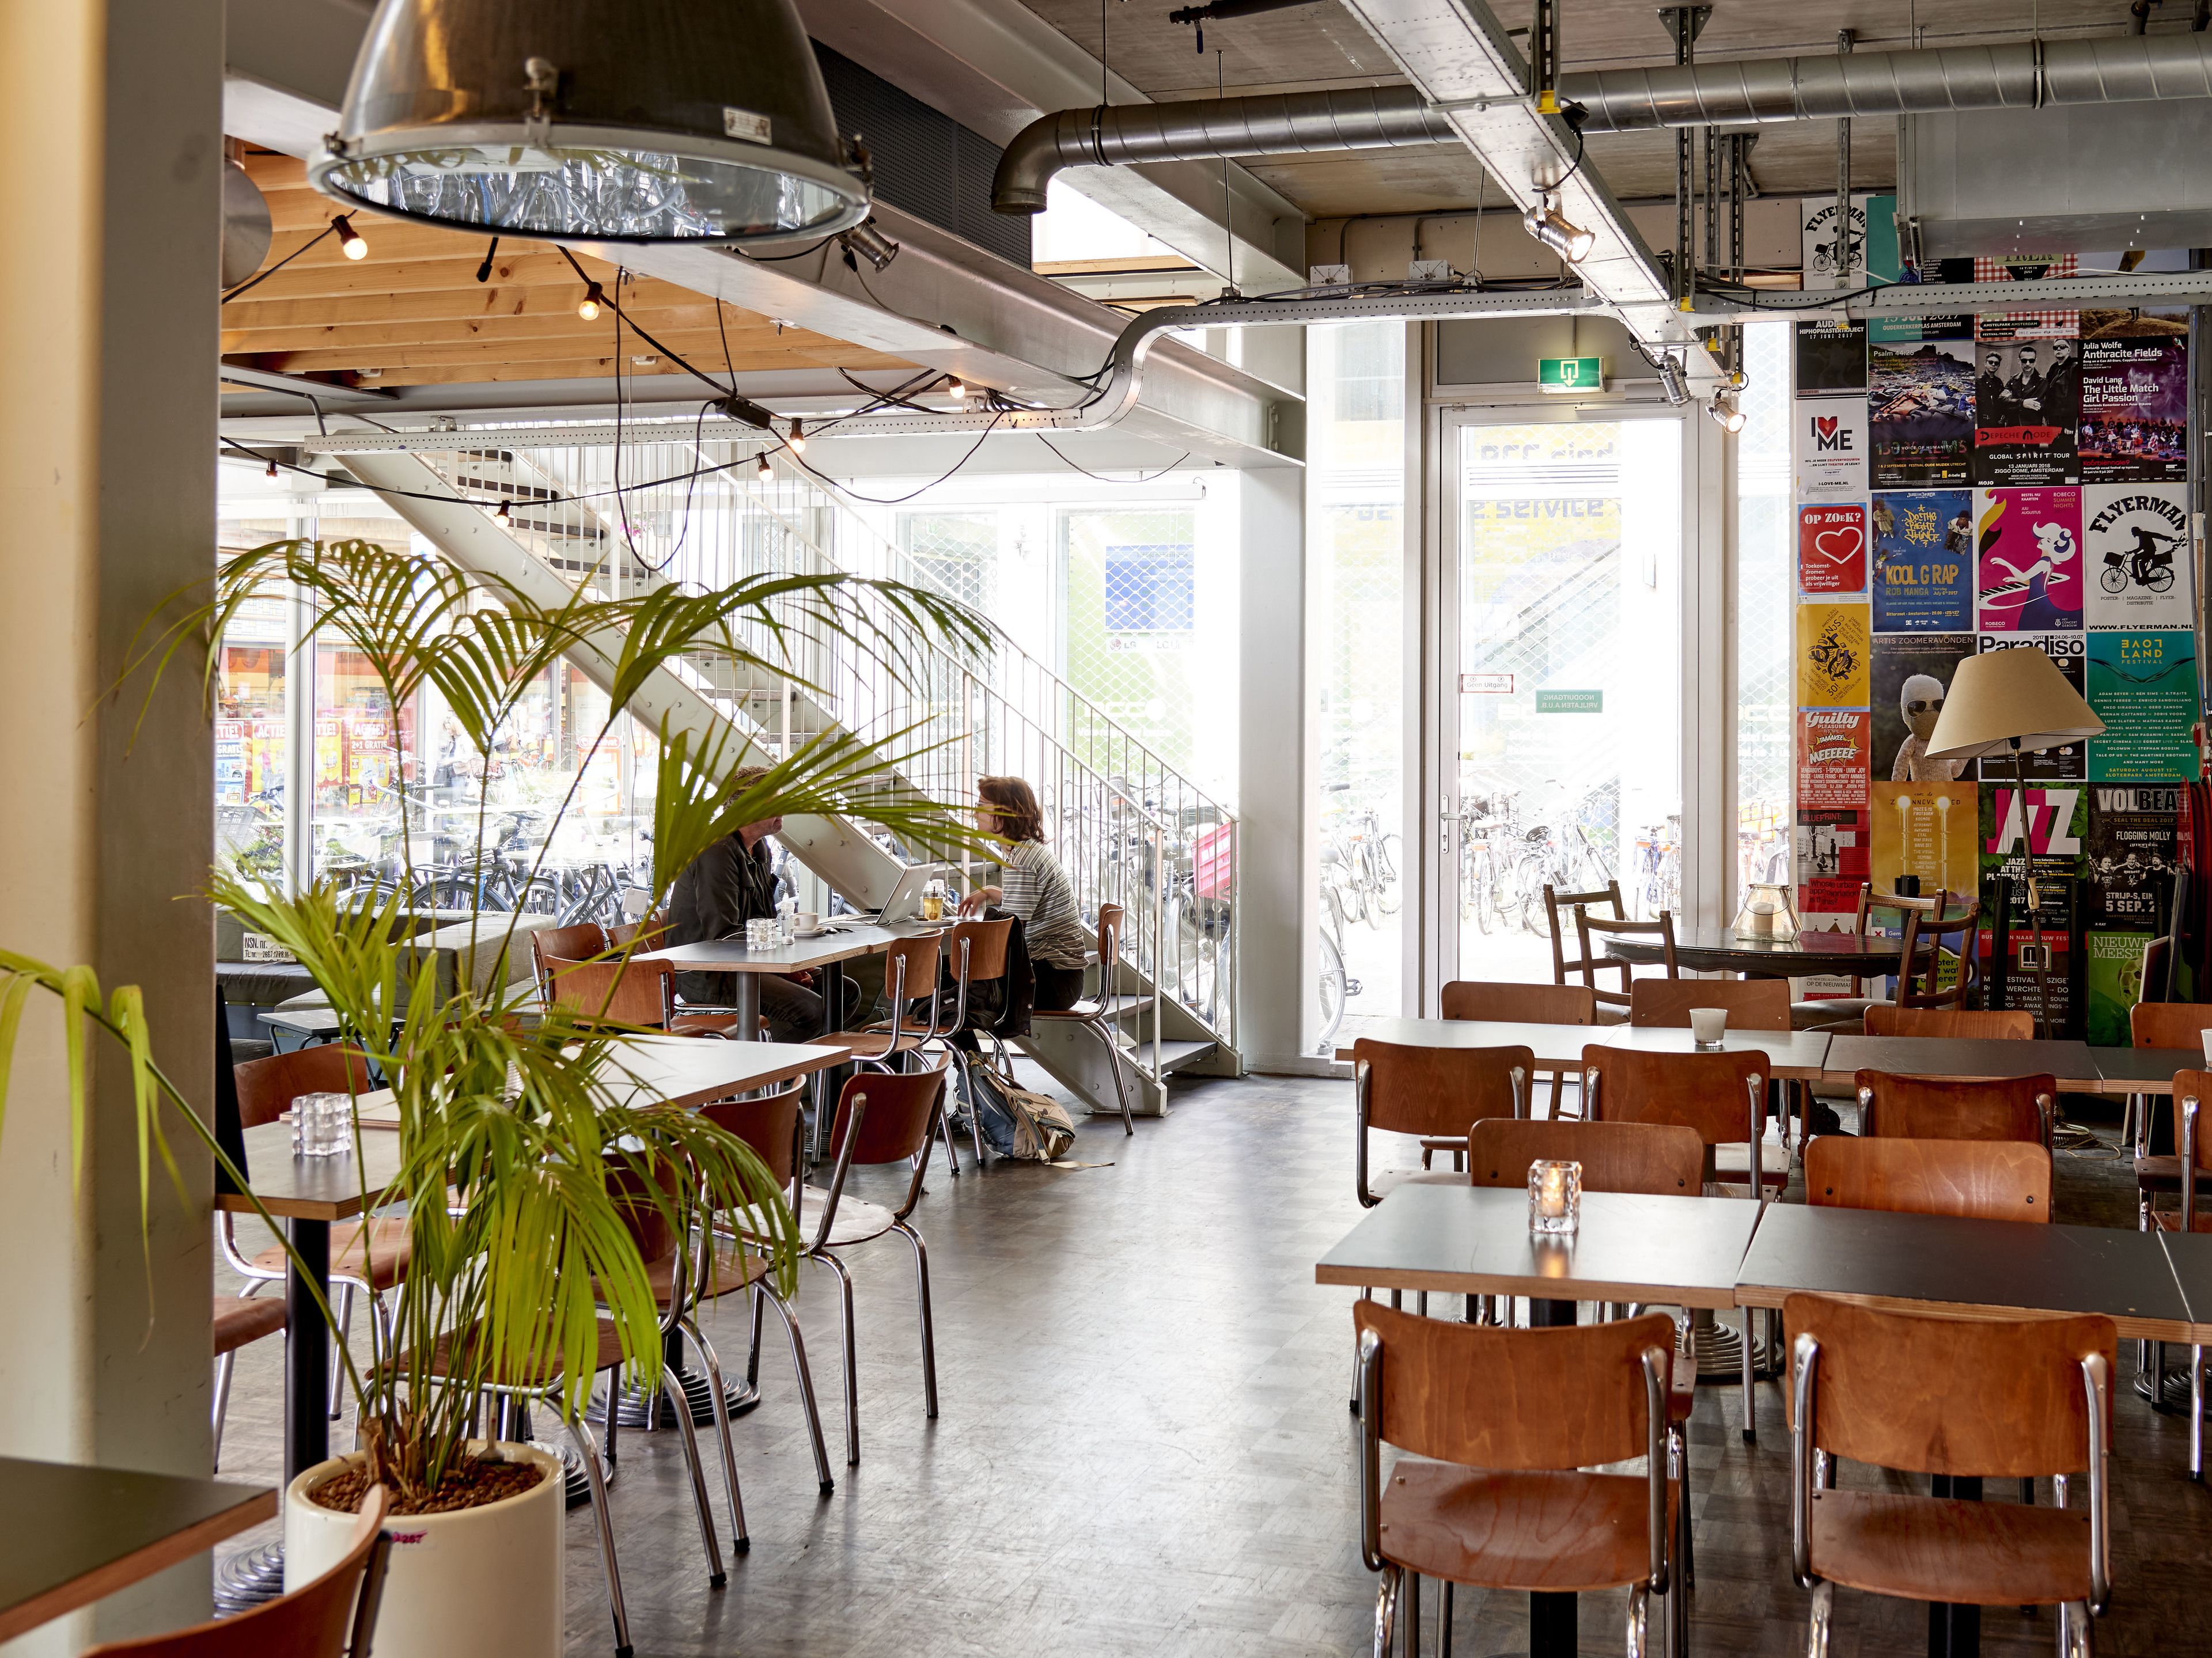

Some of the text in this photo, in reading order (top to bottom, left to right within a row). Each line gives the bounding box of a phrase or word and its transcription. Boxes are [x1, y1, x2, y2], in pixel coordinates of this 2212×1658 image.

[2084, 348, 2162, 359] Anthracite Fields
[2084, 384, 2158, 393] The Little Match
[2084, 394, 2138, 403] Girl Passion
[1818, 430, 1853, 451] ME
[1980, 429, 2050, 441] DEPECHE MODE
[1805, 514, 1821, 524] OP
[2089, 496, 2187, 533] FLYERMAN
[1886, 564, 1959, 585] KOOL G RAP
[1886, 587, 1929, 595] ROB MANGA
[2122, 650, 2162, 658] LAND
[1826, 683, 1840, 696] 30!
[1806, 712, 1859, 729] Guilty
[1986, 789, 2080, 854] JAZZ
[2116, 832, 2171, 840] FLOGGING MOLLY
[2106, 892, 2140, 900] STRIJP-S,
[2106, 901, 2145, 912] 5 SEP.
[245, 938, 259, 948] NSN.
[2093, 936, 2150, 948] NIEUWE
